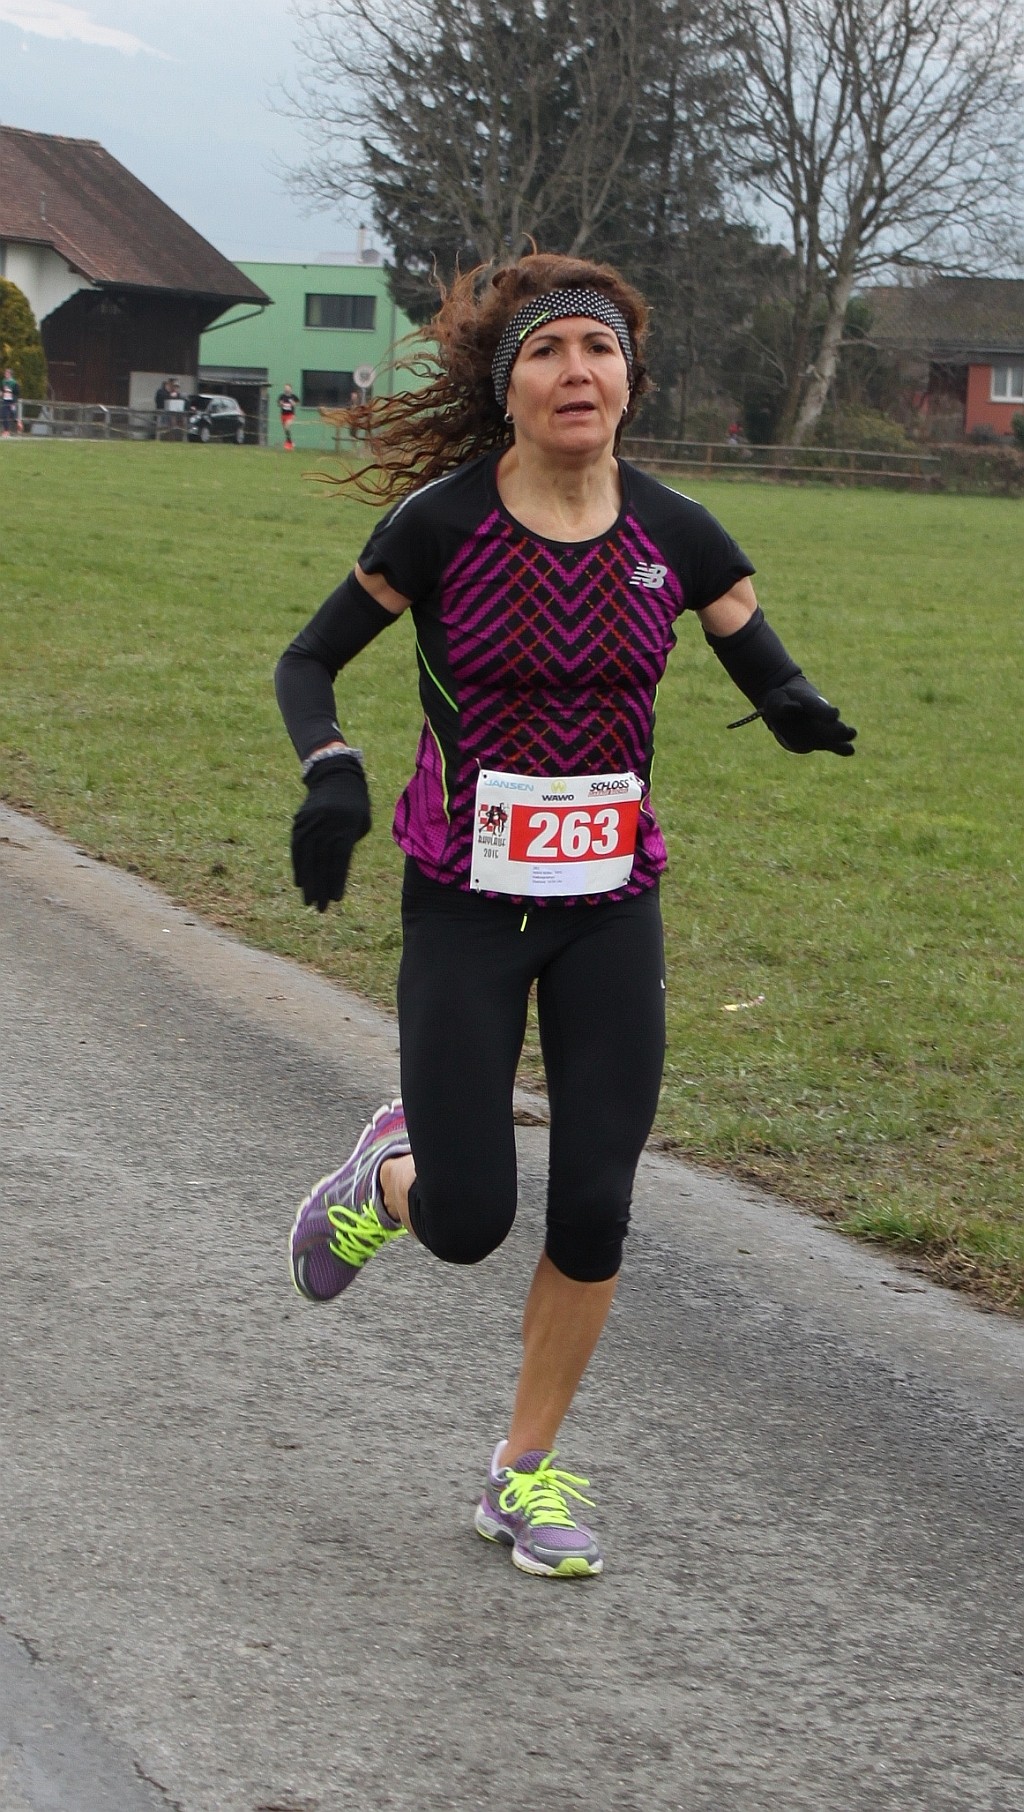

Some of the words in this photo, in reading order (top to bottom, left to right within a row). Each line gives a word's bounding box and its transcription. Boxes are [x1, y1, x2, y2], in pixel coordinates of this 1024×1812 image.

[484, 780, 534, 792] JANSEN
[590, 779, 629, 791] SCHLOSS
[526, 808, 620, 858] 263
